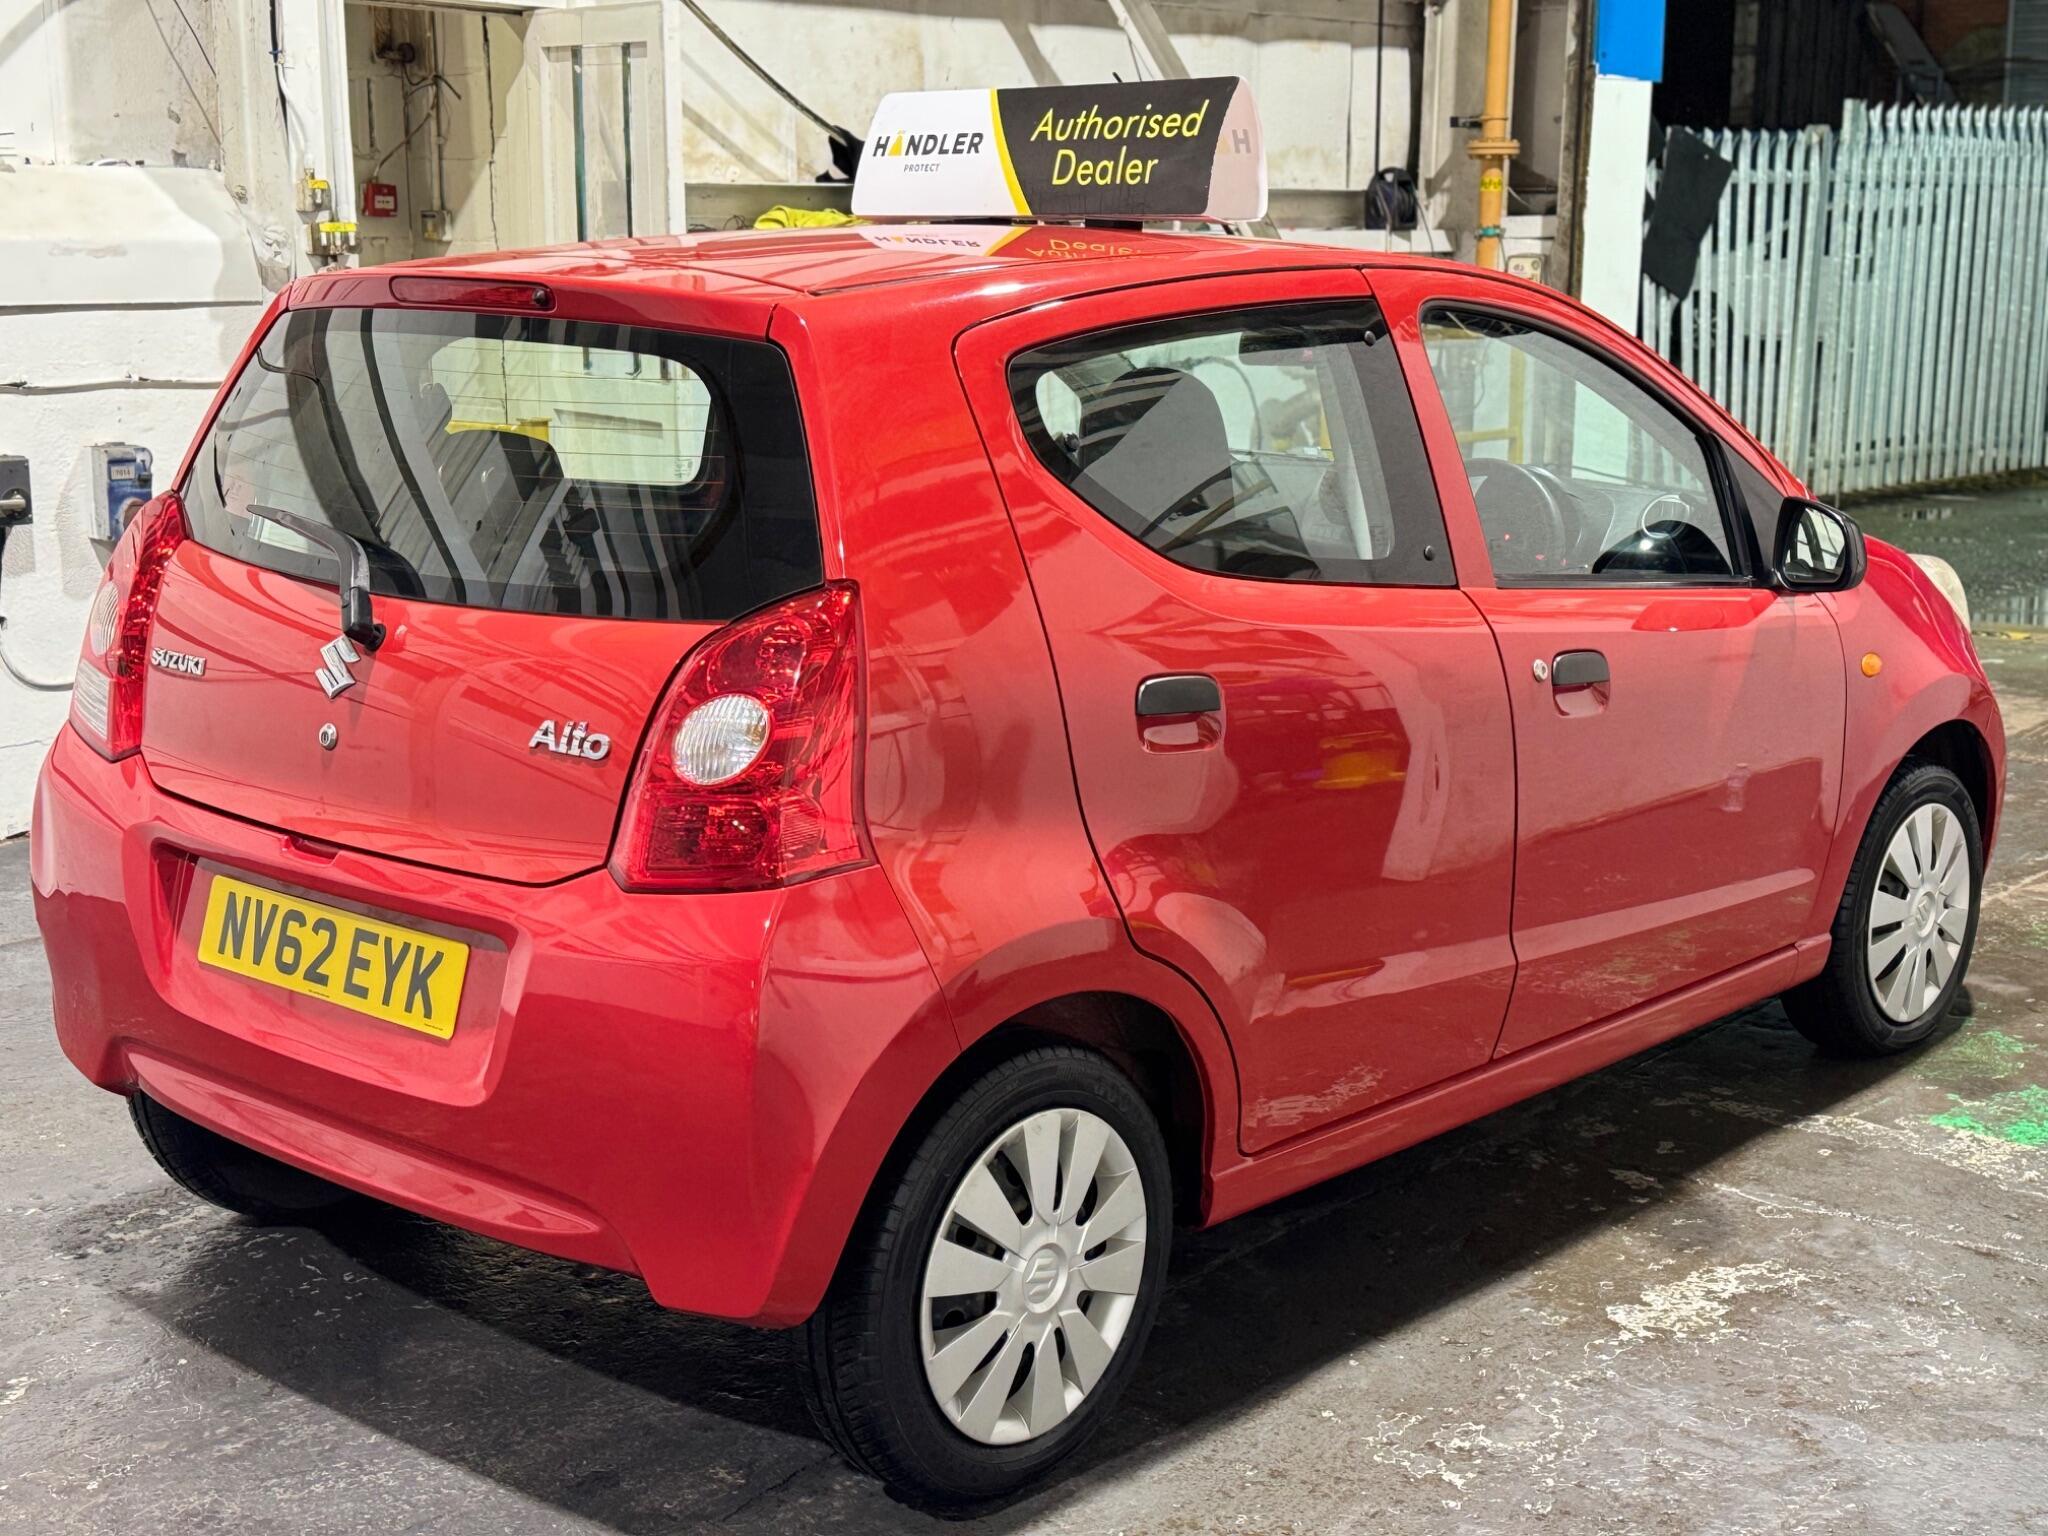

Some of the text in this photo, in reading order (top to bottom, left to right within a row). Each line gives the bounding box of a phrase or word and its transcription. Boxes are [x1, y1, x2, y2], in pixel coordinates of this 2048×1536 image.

[1029, 98, 1210, 142] Authorised
[904, 163, 940, 172] PROTECT
[1051, 145, 1159, 186] Dealer
[151, 647, 206, 676] SUZUKI
[528, 719, 611, 761] Alto
[217, 890, 445, 1020] NV62 EYK
